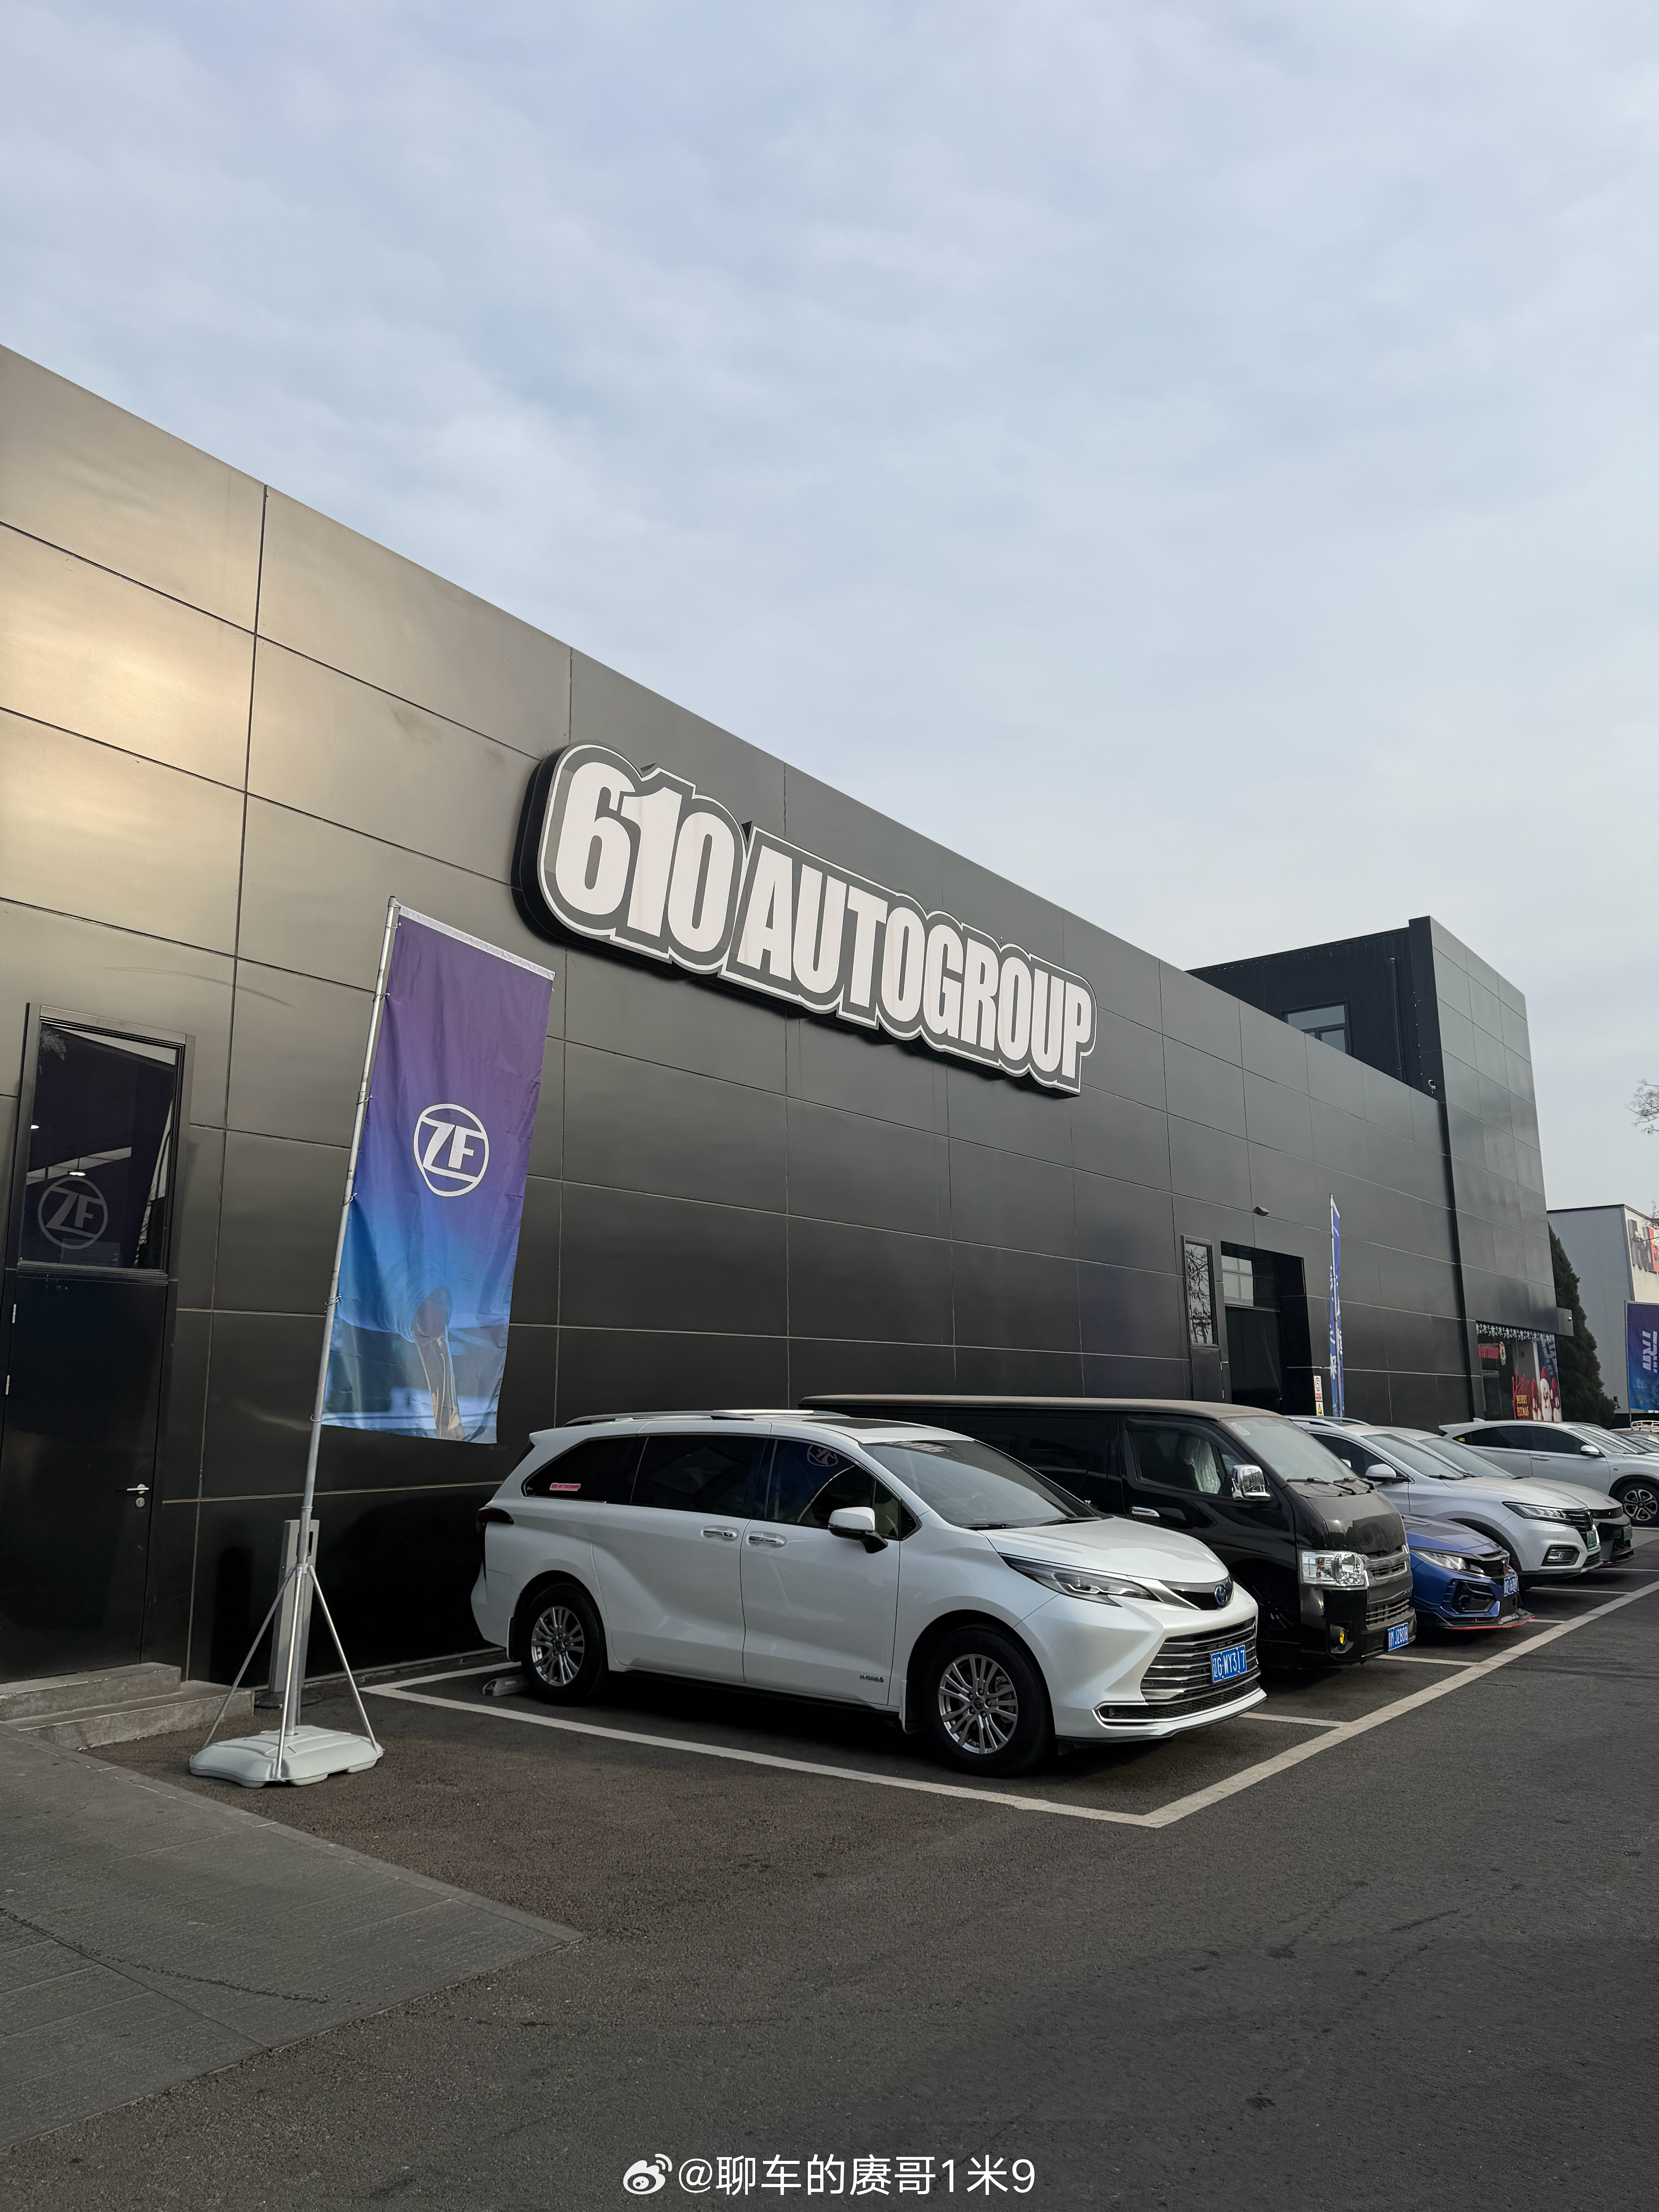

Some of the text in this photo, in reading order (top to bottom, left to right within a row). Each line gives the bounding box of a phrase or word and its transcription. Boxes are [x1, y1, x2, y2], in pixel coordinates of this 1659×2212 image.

[555, 761, 1092, 1079] 610 AUTOGROUP
[418, 1114, 486, 1185] ZF
[44, 1185, 105, 1239] ZF
[1642, 1330, 1658, 1374] TRW
